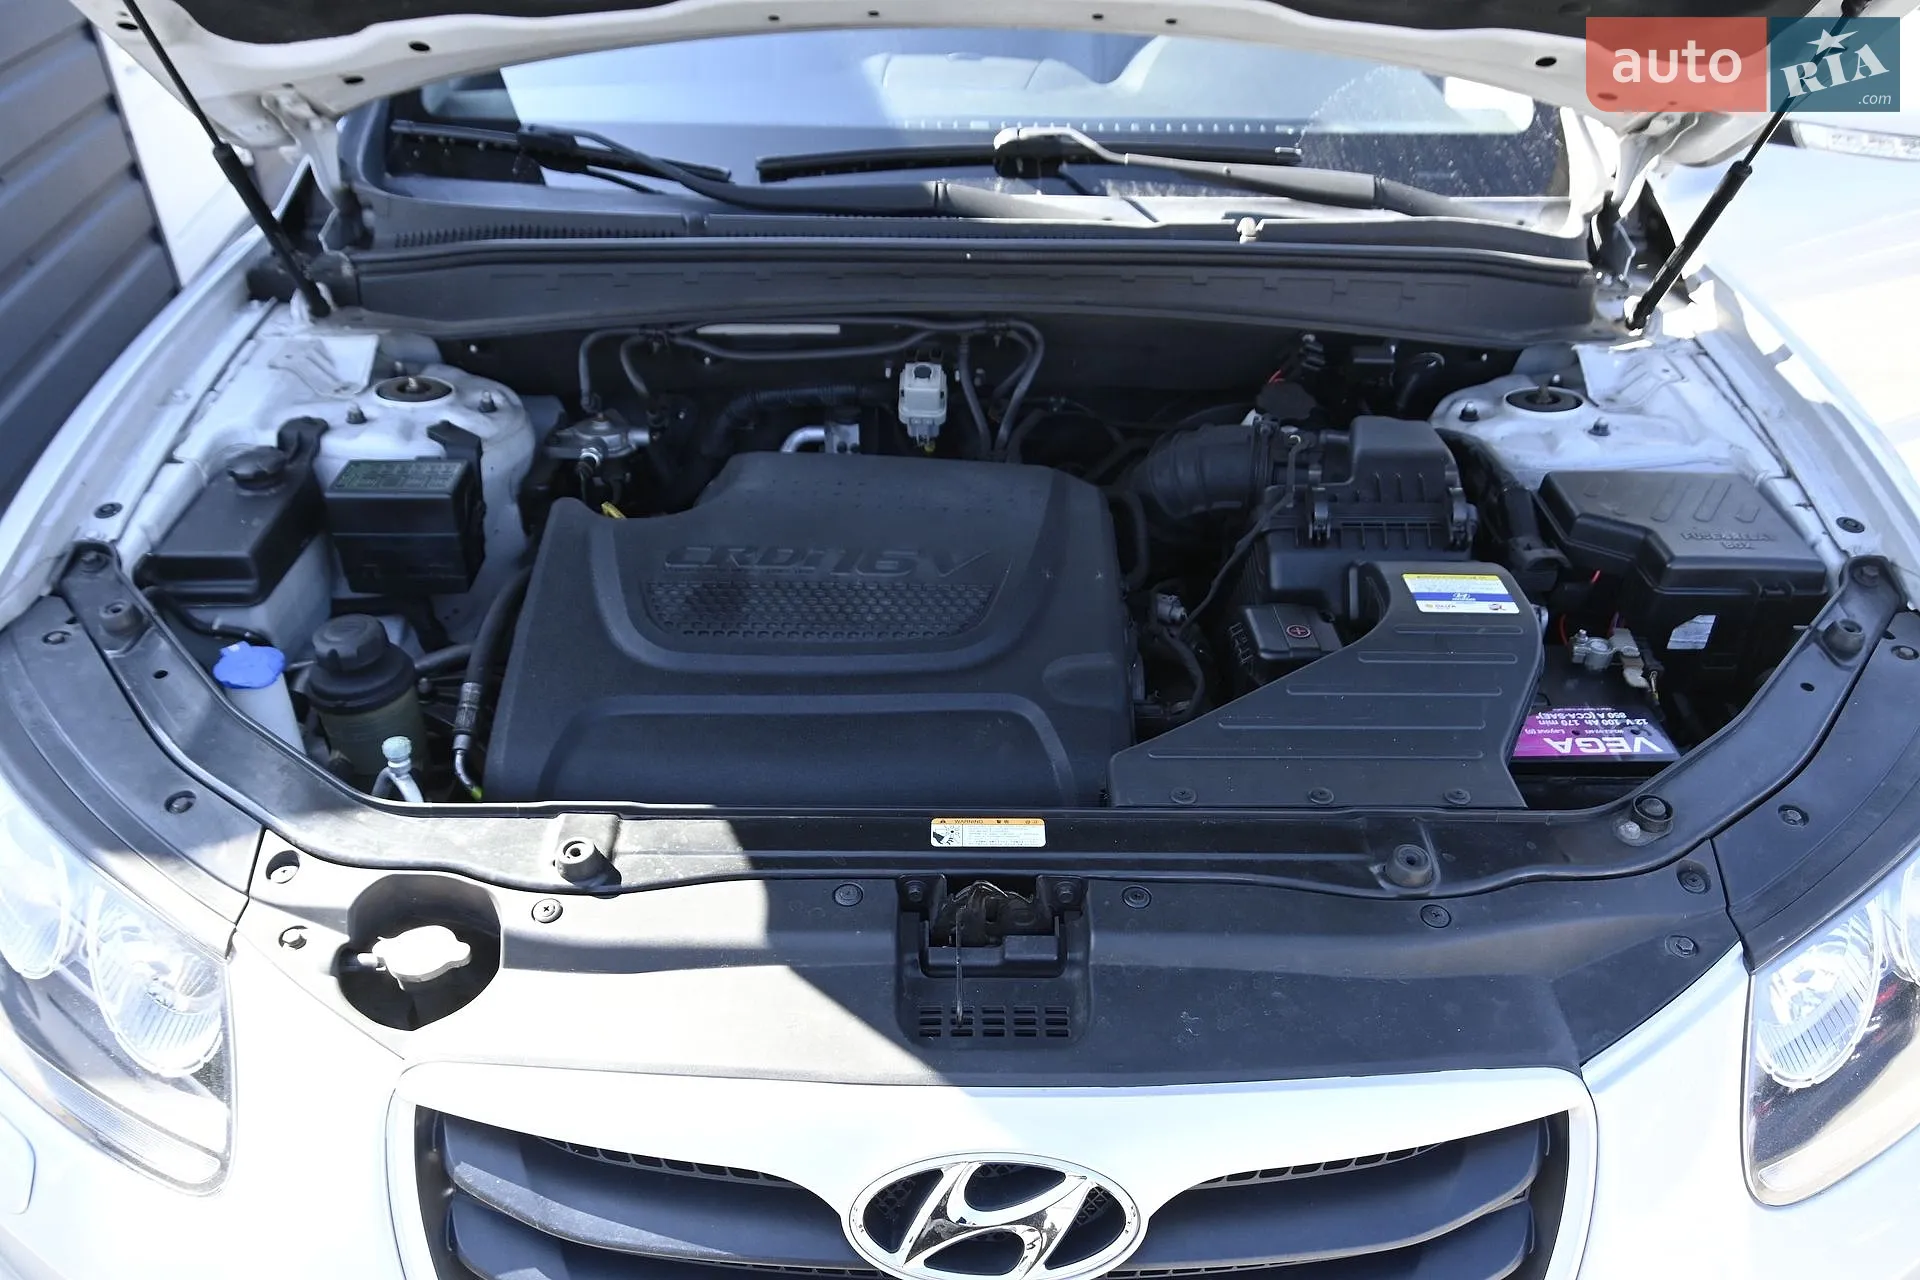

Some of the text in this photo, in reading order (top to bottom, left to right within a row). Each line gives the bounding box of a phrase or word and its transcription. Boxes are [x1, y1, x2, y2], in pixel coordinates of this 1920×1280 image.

[1596, 711, 1606, 719] A
[1585, 718, 1599, 726] Ah
[1601, 718, 1621, 726] 100
[1543, 736, 1664, 753] VEGA
